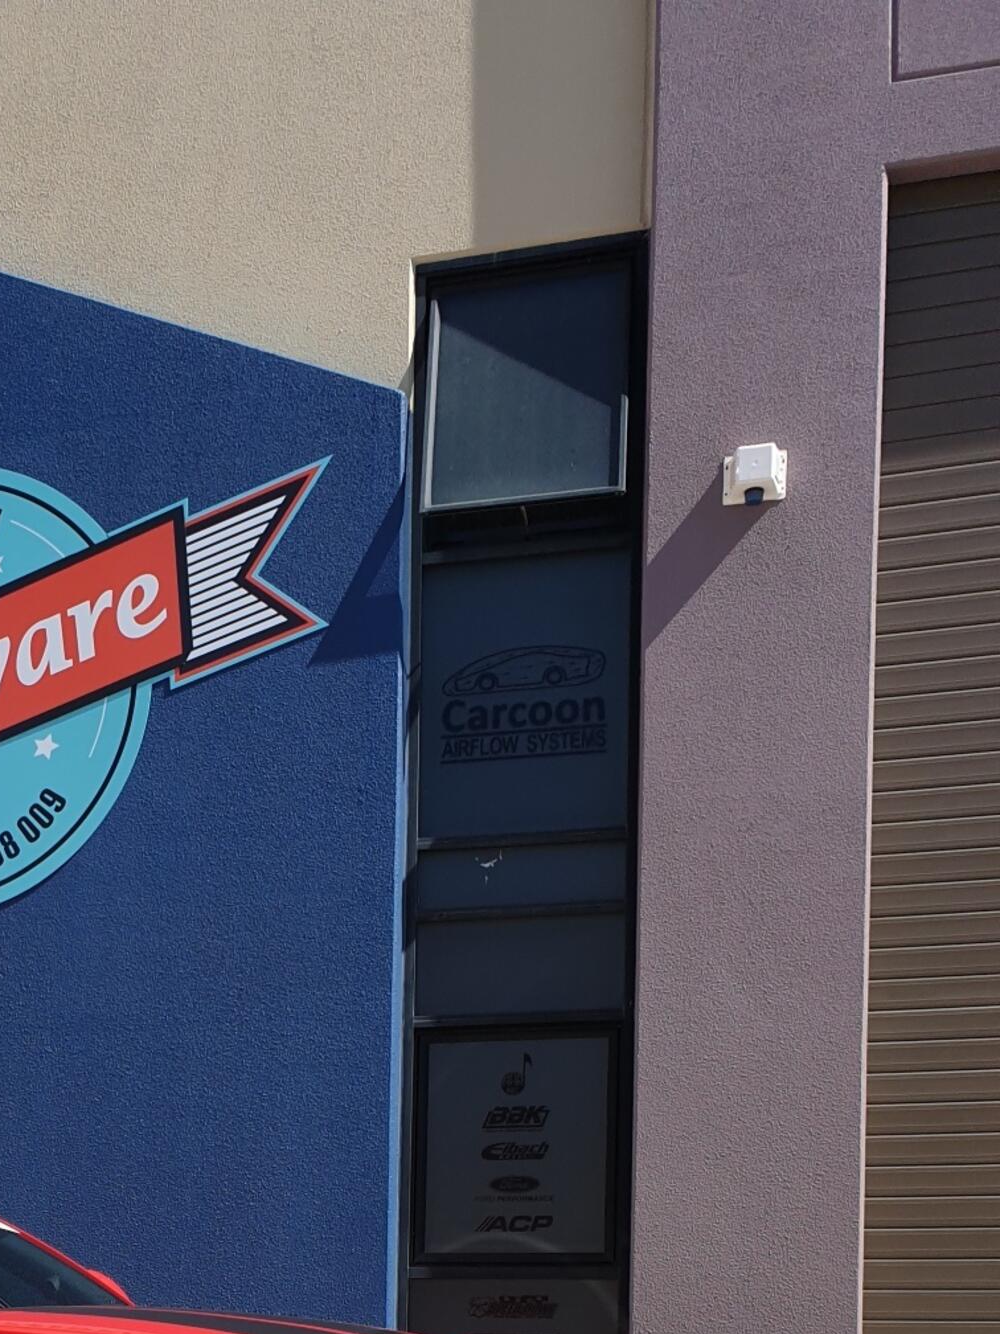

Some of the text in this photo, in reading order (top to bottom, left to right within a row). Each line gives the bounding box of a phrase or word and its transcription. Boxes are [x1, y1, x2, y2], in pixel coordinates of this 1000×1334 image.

[442, 696, 606, 732] Carcoon
[442, 729, 606, 758] AIRFLOW SYSTEMS
[17, 788, 67, 843] 009
[484, 1105, 549, 1128] BBK
